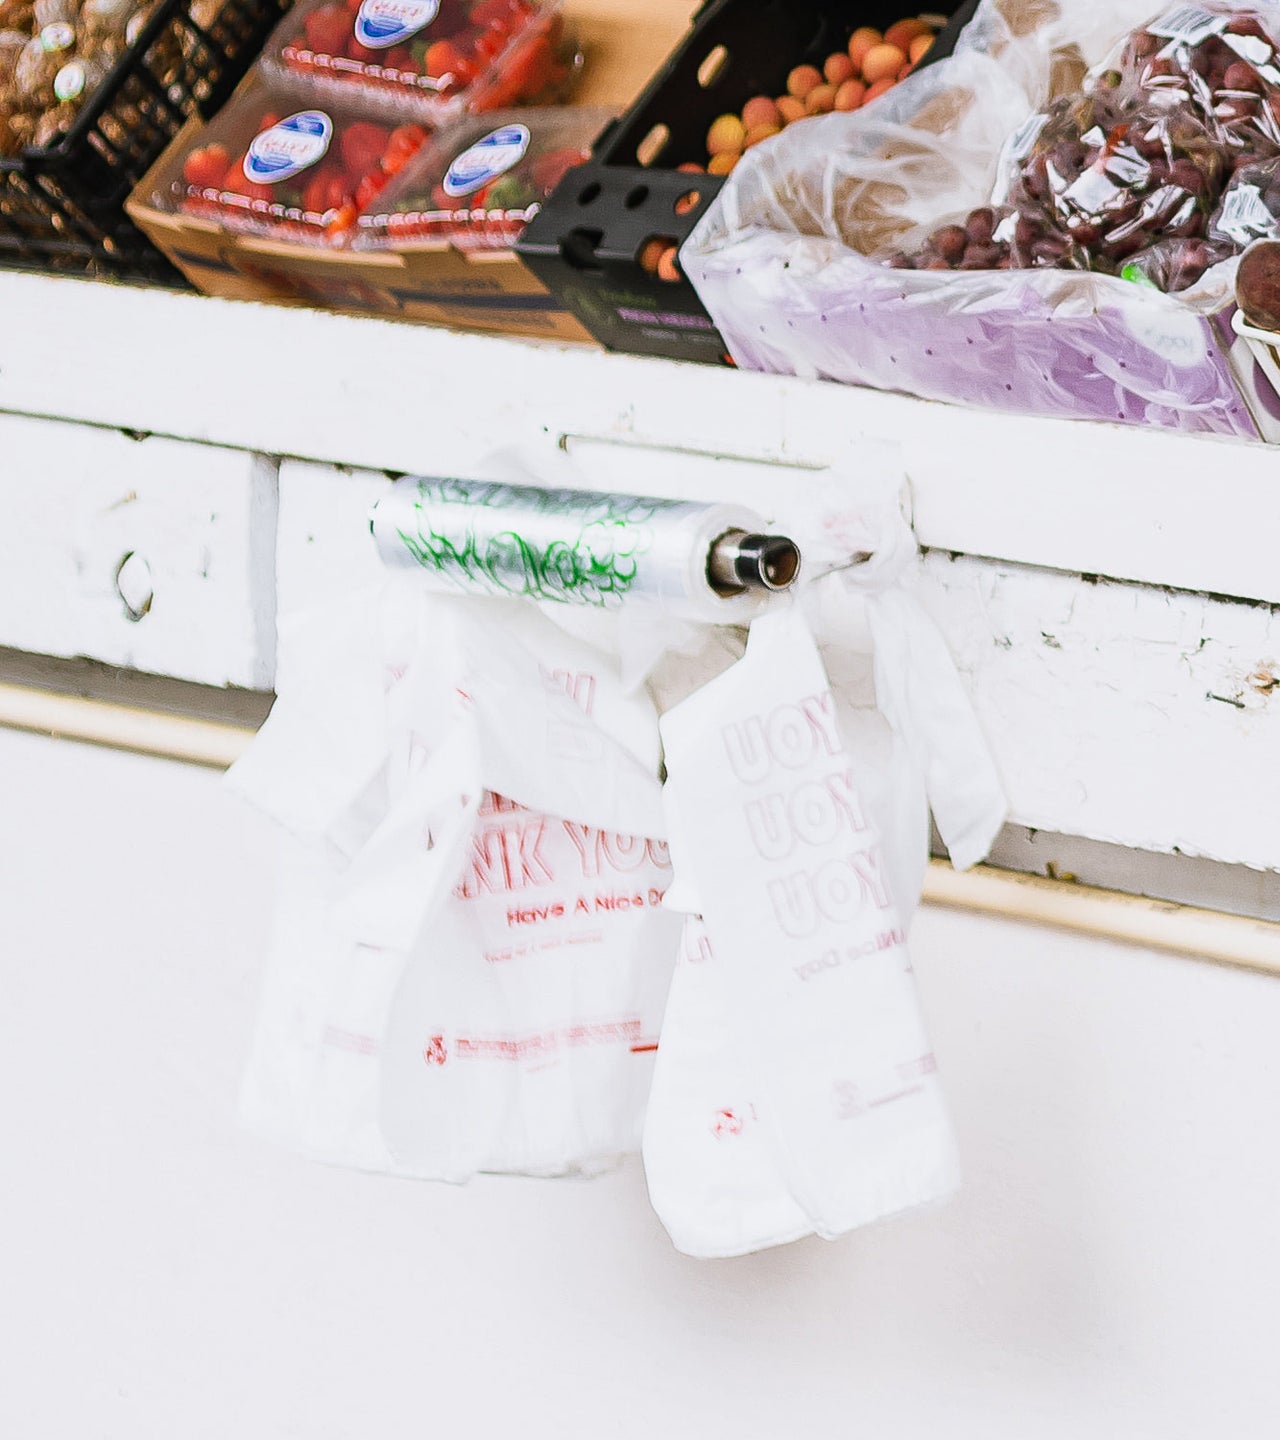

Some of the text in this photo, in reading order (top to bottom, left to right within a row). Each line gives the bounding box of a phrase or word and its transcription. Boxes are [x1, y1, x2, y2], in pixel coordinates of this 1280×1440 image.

[506, 900, 564, 928] Have
[573, 896, 590, 916] A
[595, 888, 646, 915] Nice
